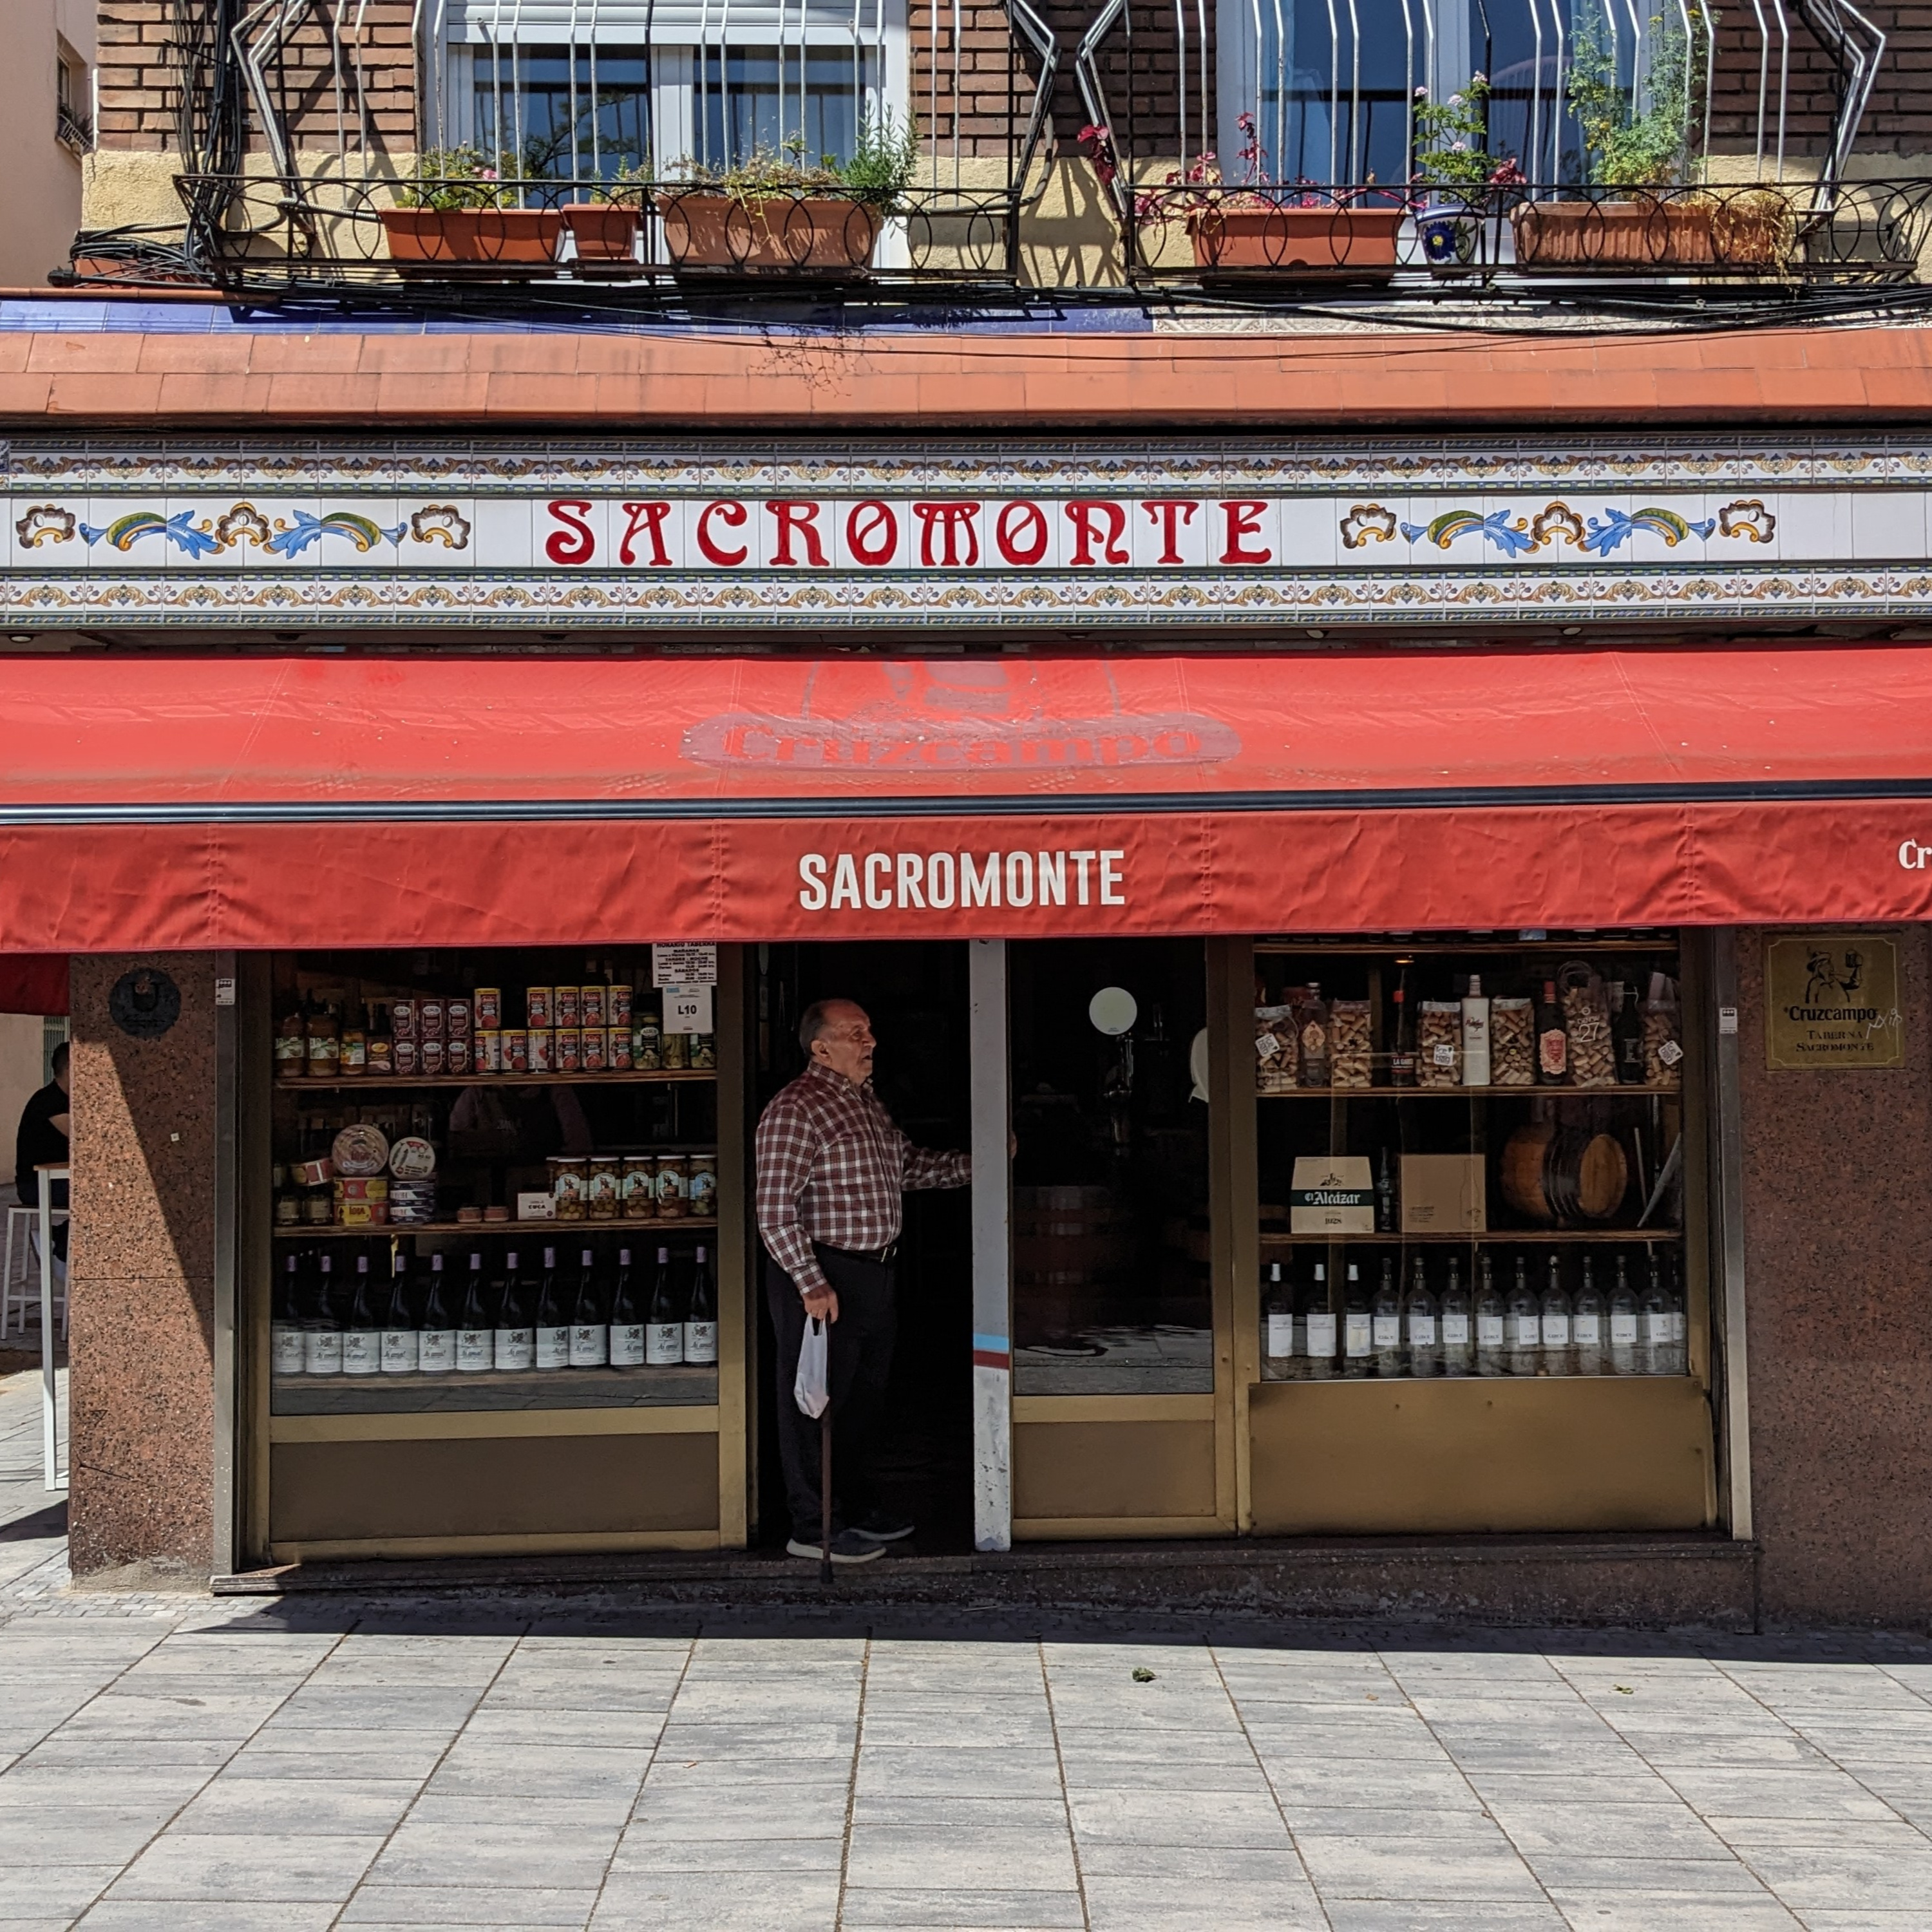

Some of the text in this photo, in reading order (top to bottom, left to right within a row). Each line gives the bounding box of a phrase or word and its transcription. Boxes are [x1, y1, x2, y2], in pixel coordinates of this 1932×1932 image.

[545, 500, 1272, 567] SACROMONTE
[723, 723, 1203, 765] Cruzcampo
[1897, 838, 1932, 869] Cr
[799, 849, 1126, 910] SACROMONTE
[677, 1005, 697, 1015] L10
[1789, 1005, 1877, 1023] Cruzcampo
[1578, 1021, 1600, 1043] 27
[1807, 1030, 1864, 1040] TABERNA
[1795, 1042, 1875, 1052] SACROMONTE
[1312, 1191, 1361, 1205] Alcázar
